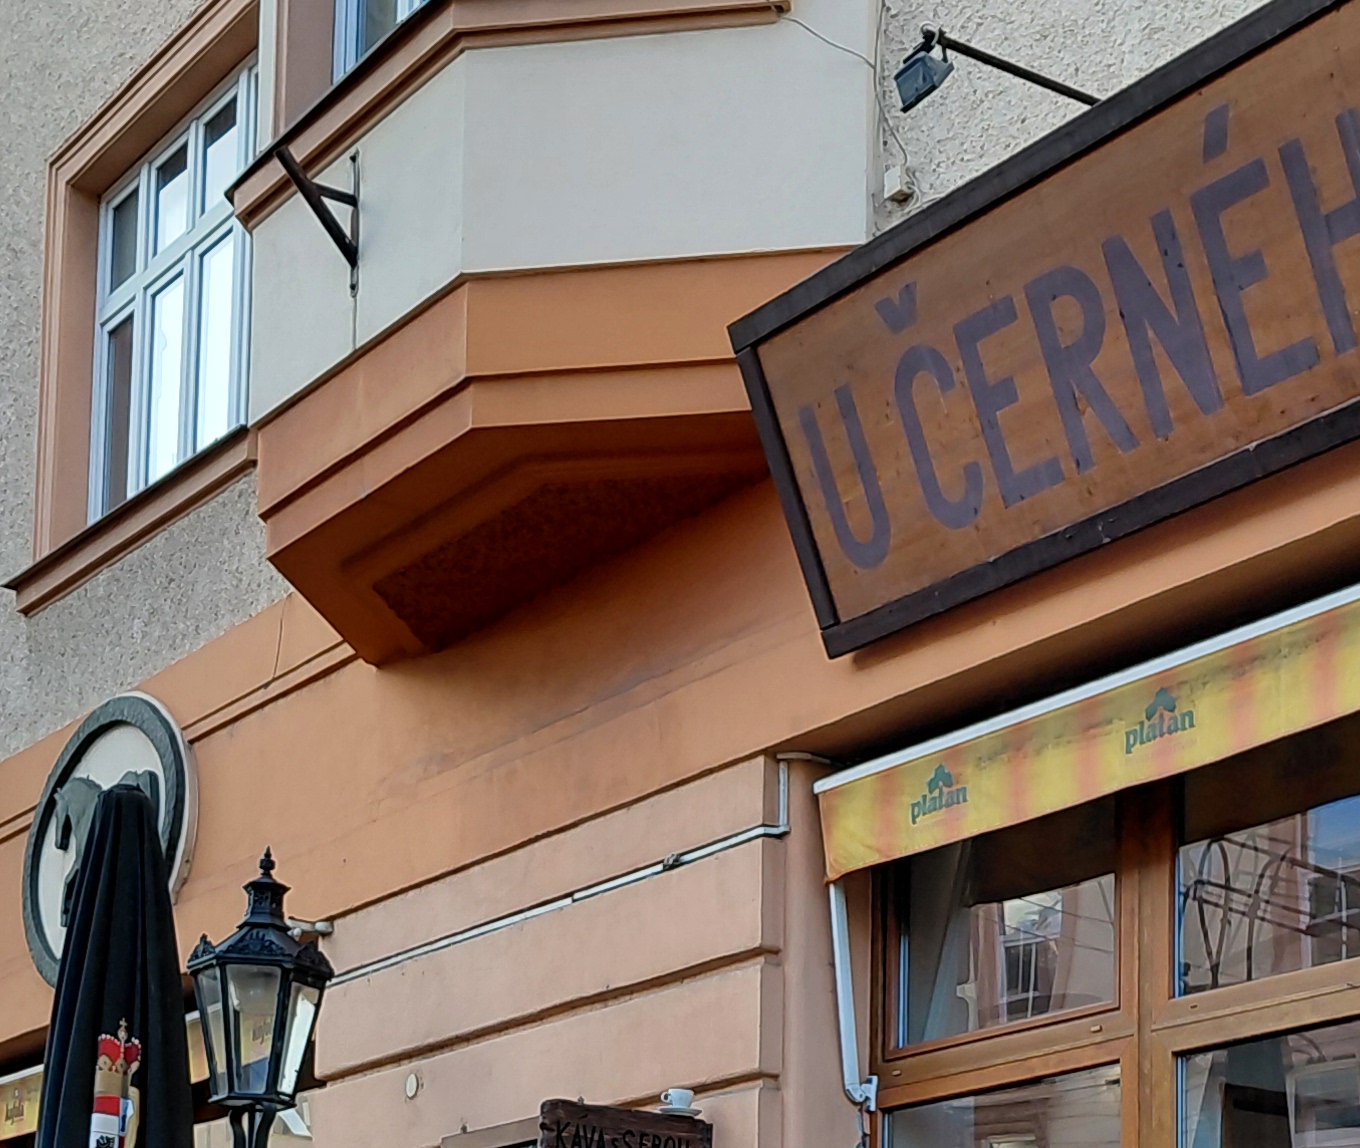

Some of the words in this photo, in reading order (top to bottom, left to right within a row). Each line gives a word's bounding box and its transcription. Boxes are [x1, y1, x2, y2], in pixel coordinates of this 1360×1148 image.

[797, 382, 891, 570] U
[1125, 706, 1196, 754] platan
[910, 783, 969, 825] platan
